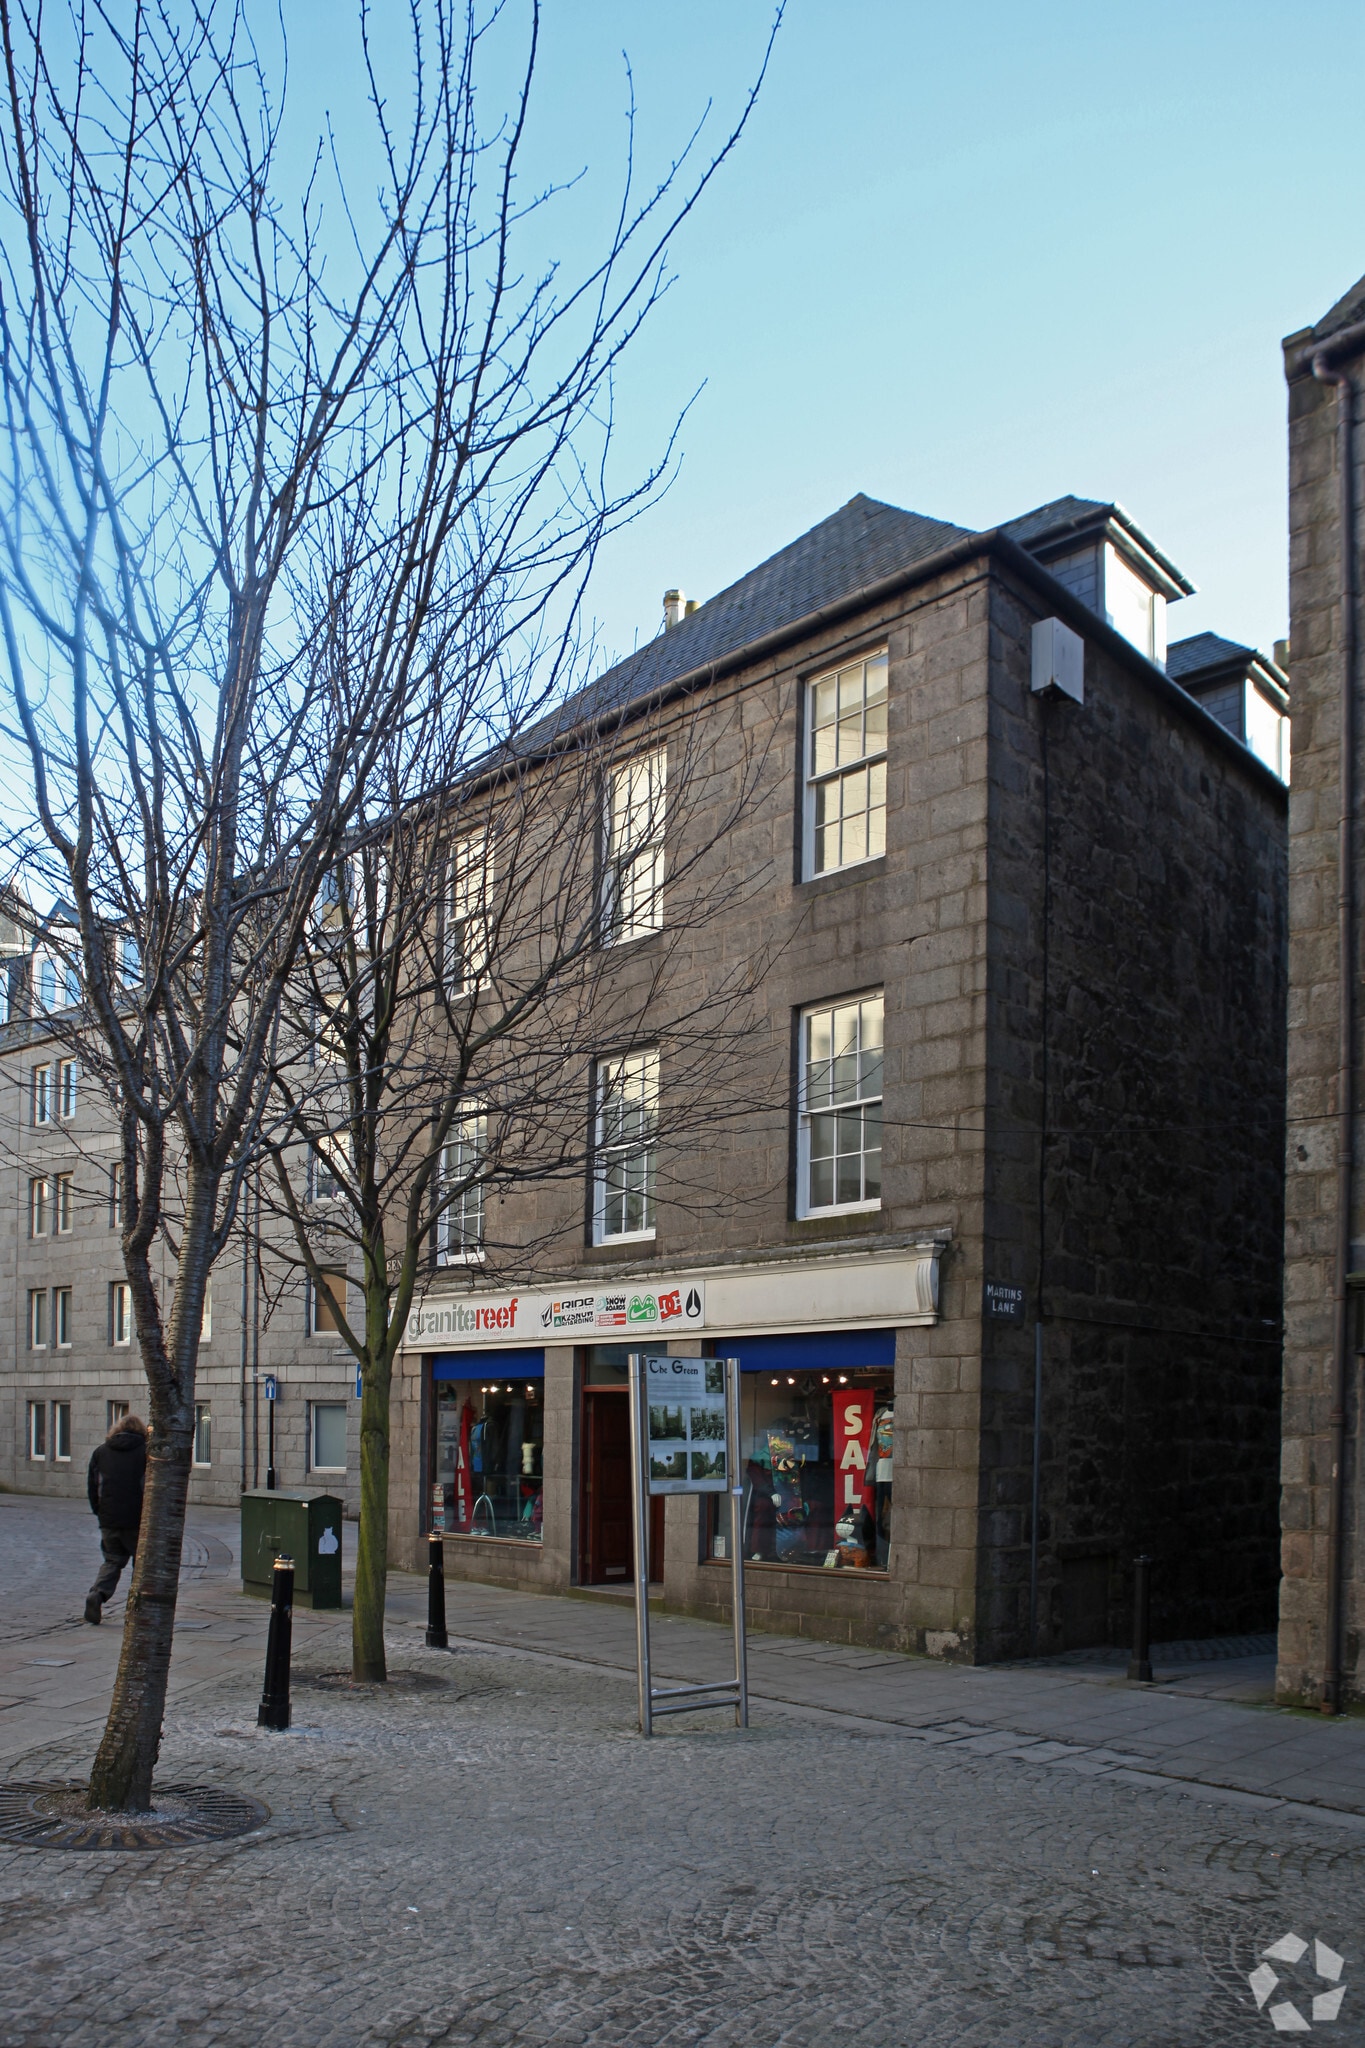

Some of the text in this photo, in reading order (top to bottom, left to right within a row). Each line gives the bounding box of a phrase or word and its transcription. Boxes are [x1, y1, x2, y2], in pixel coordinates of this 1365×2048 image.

[987, 1284, 1022, 1301] MARTINS
[562, 1297, 594, 1310] RIDE
[992, 1299, 1015, 1314] LANE
[648, 1360, 699, 1375] The Green
[840, 1404, 867, 1514] SAL
[457, 1446, 467, 1522] ALE
